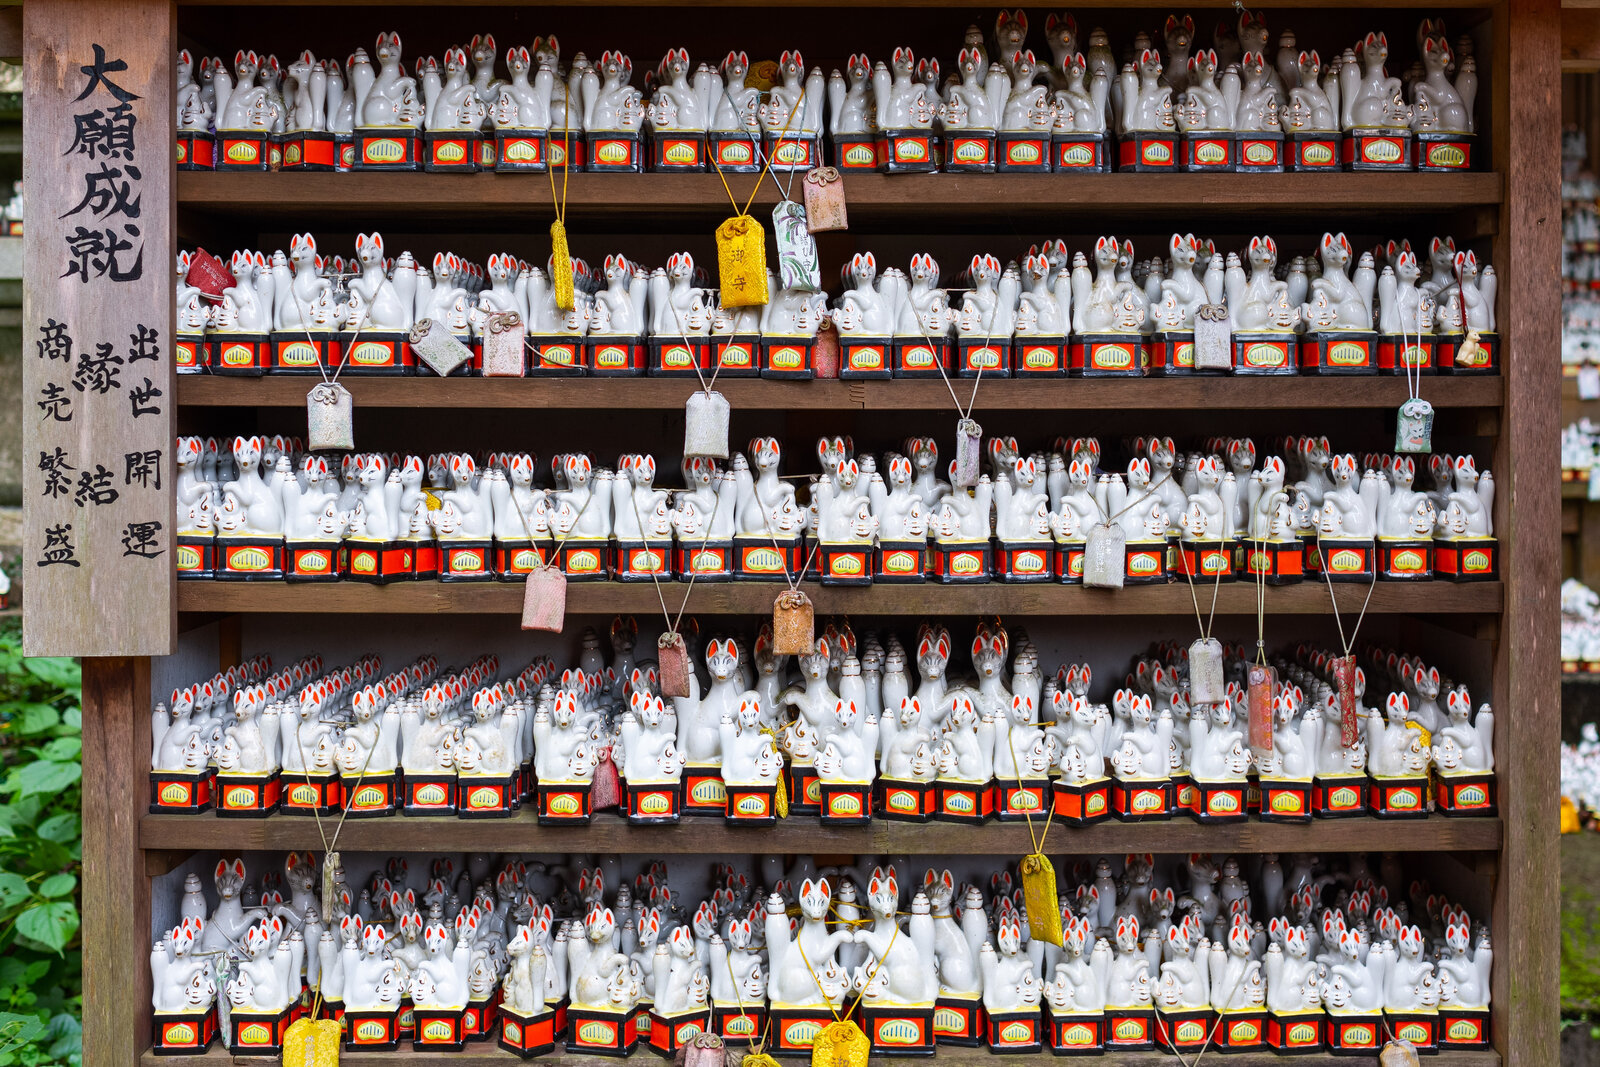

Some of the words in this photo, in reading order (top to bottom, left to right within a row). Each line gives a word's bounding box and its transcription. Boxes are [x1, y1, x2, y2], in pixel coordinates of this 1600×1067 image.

[58, 43, 145, 284] 大願成就
[37, 318, 81, 567] 商売繁盛
[72, 343, 125, 507] 縁結
[121, 324, 166, 559] 出世開運
